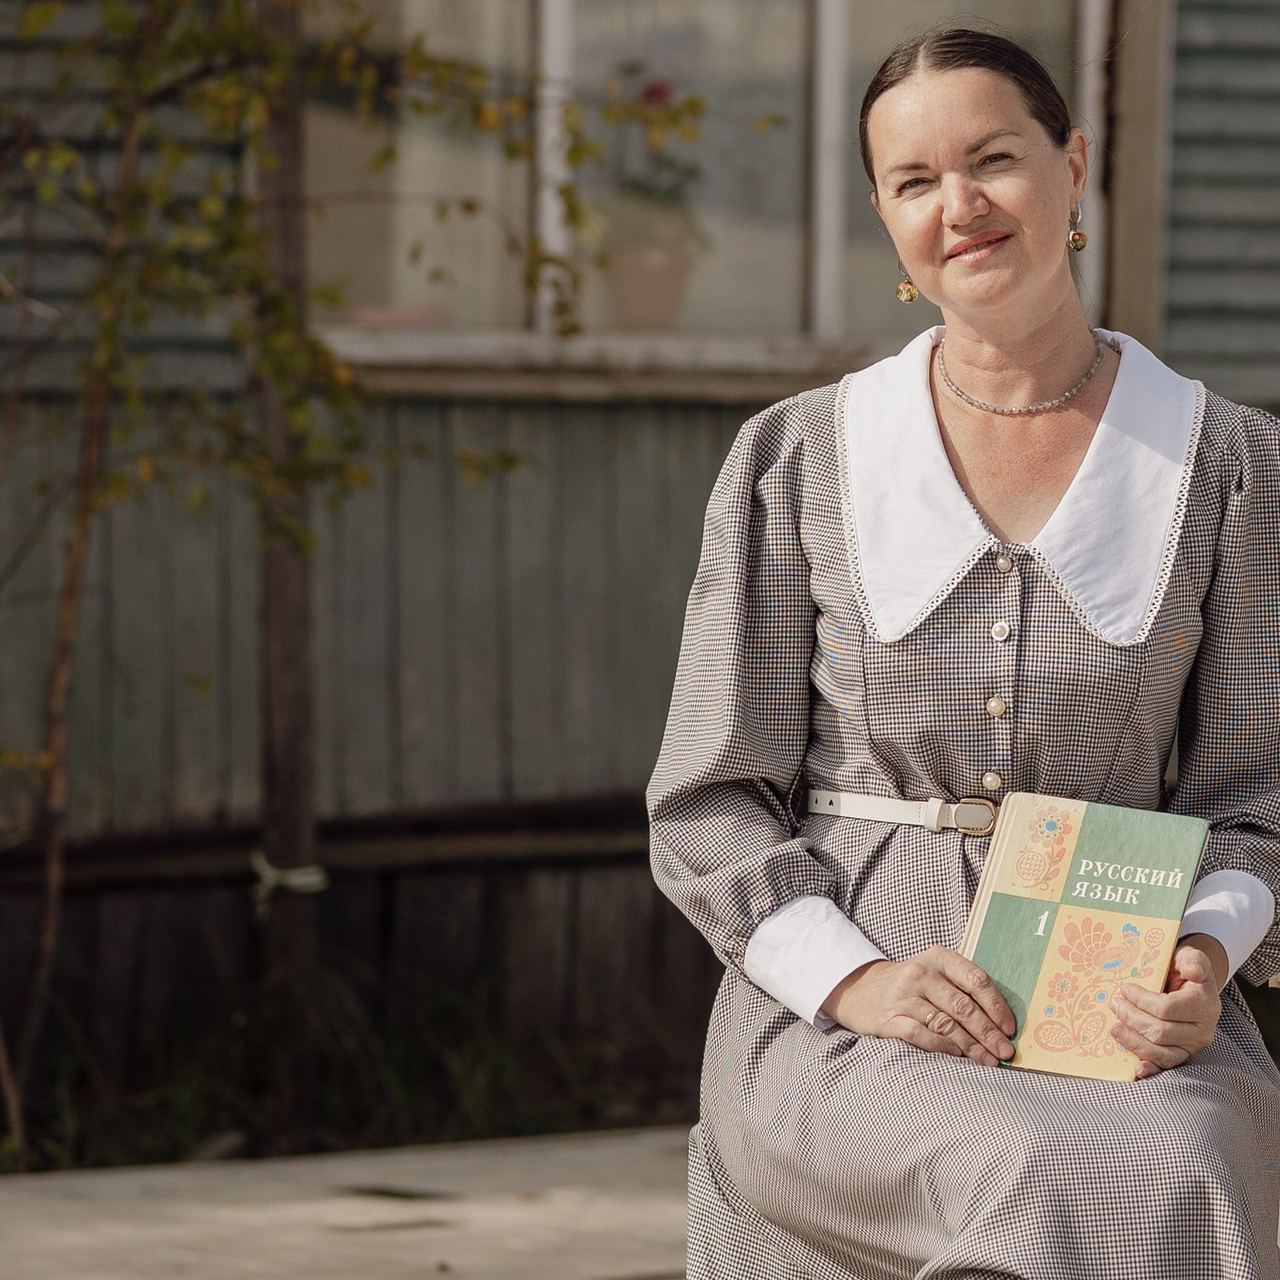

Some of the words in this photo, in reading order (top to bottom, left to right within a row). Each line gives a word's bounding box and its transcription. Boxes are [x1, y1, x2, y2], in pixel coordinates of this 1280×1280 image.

[1077, 858, 1184, 890] РУССКИЙ
[1071, 880, 1141, 905] ЯЗЫК
[1034, 910, 1050, 937] 1
